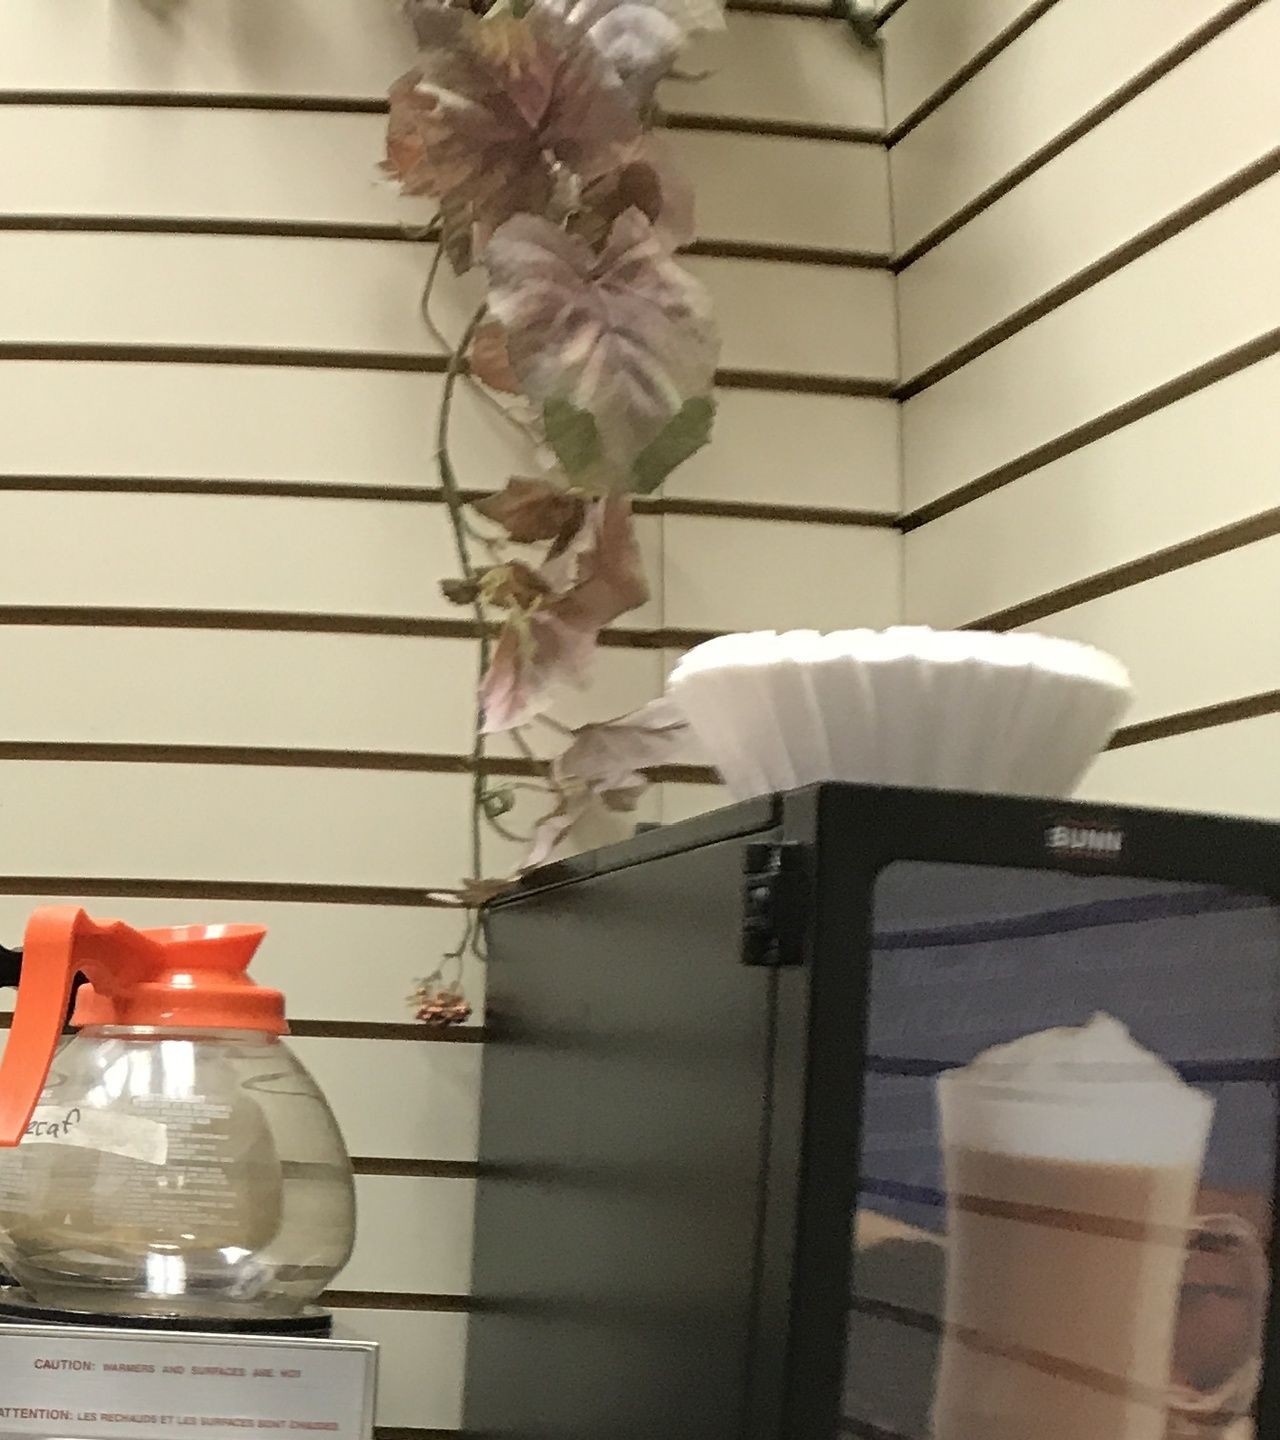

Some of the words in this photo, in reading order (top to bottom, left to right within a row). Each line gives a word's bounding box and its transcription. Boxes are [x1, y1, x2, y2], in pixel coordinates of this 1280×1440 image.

[1044, 826, 1122, 851] BUNN
[26, 1107, 81, 1138] ecaf
[34, 1358, 96, 1371] CAUTION:
[103, 1363, 155, 1374] WARMERS
[162, 1366, 185, 1375] AND
[191, 1366, 246, 1377] SURFACES
[77, 1412, 97, 1422] LES
[160, 1415, 173, 1424] ET
[176, 1416, 197, 1426] LES
